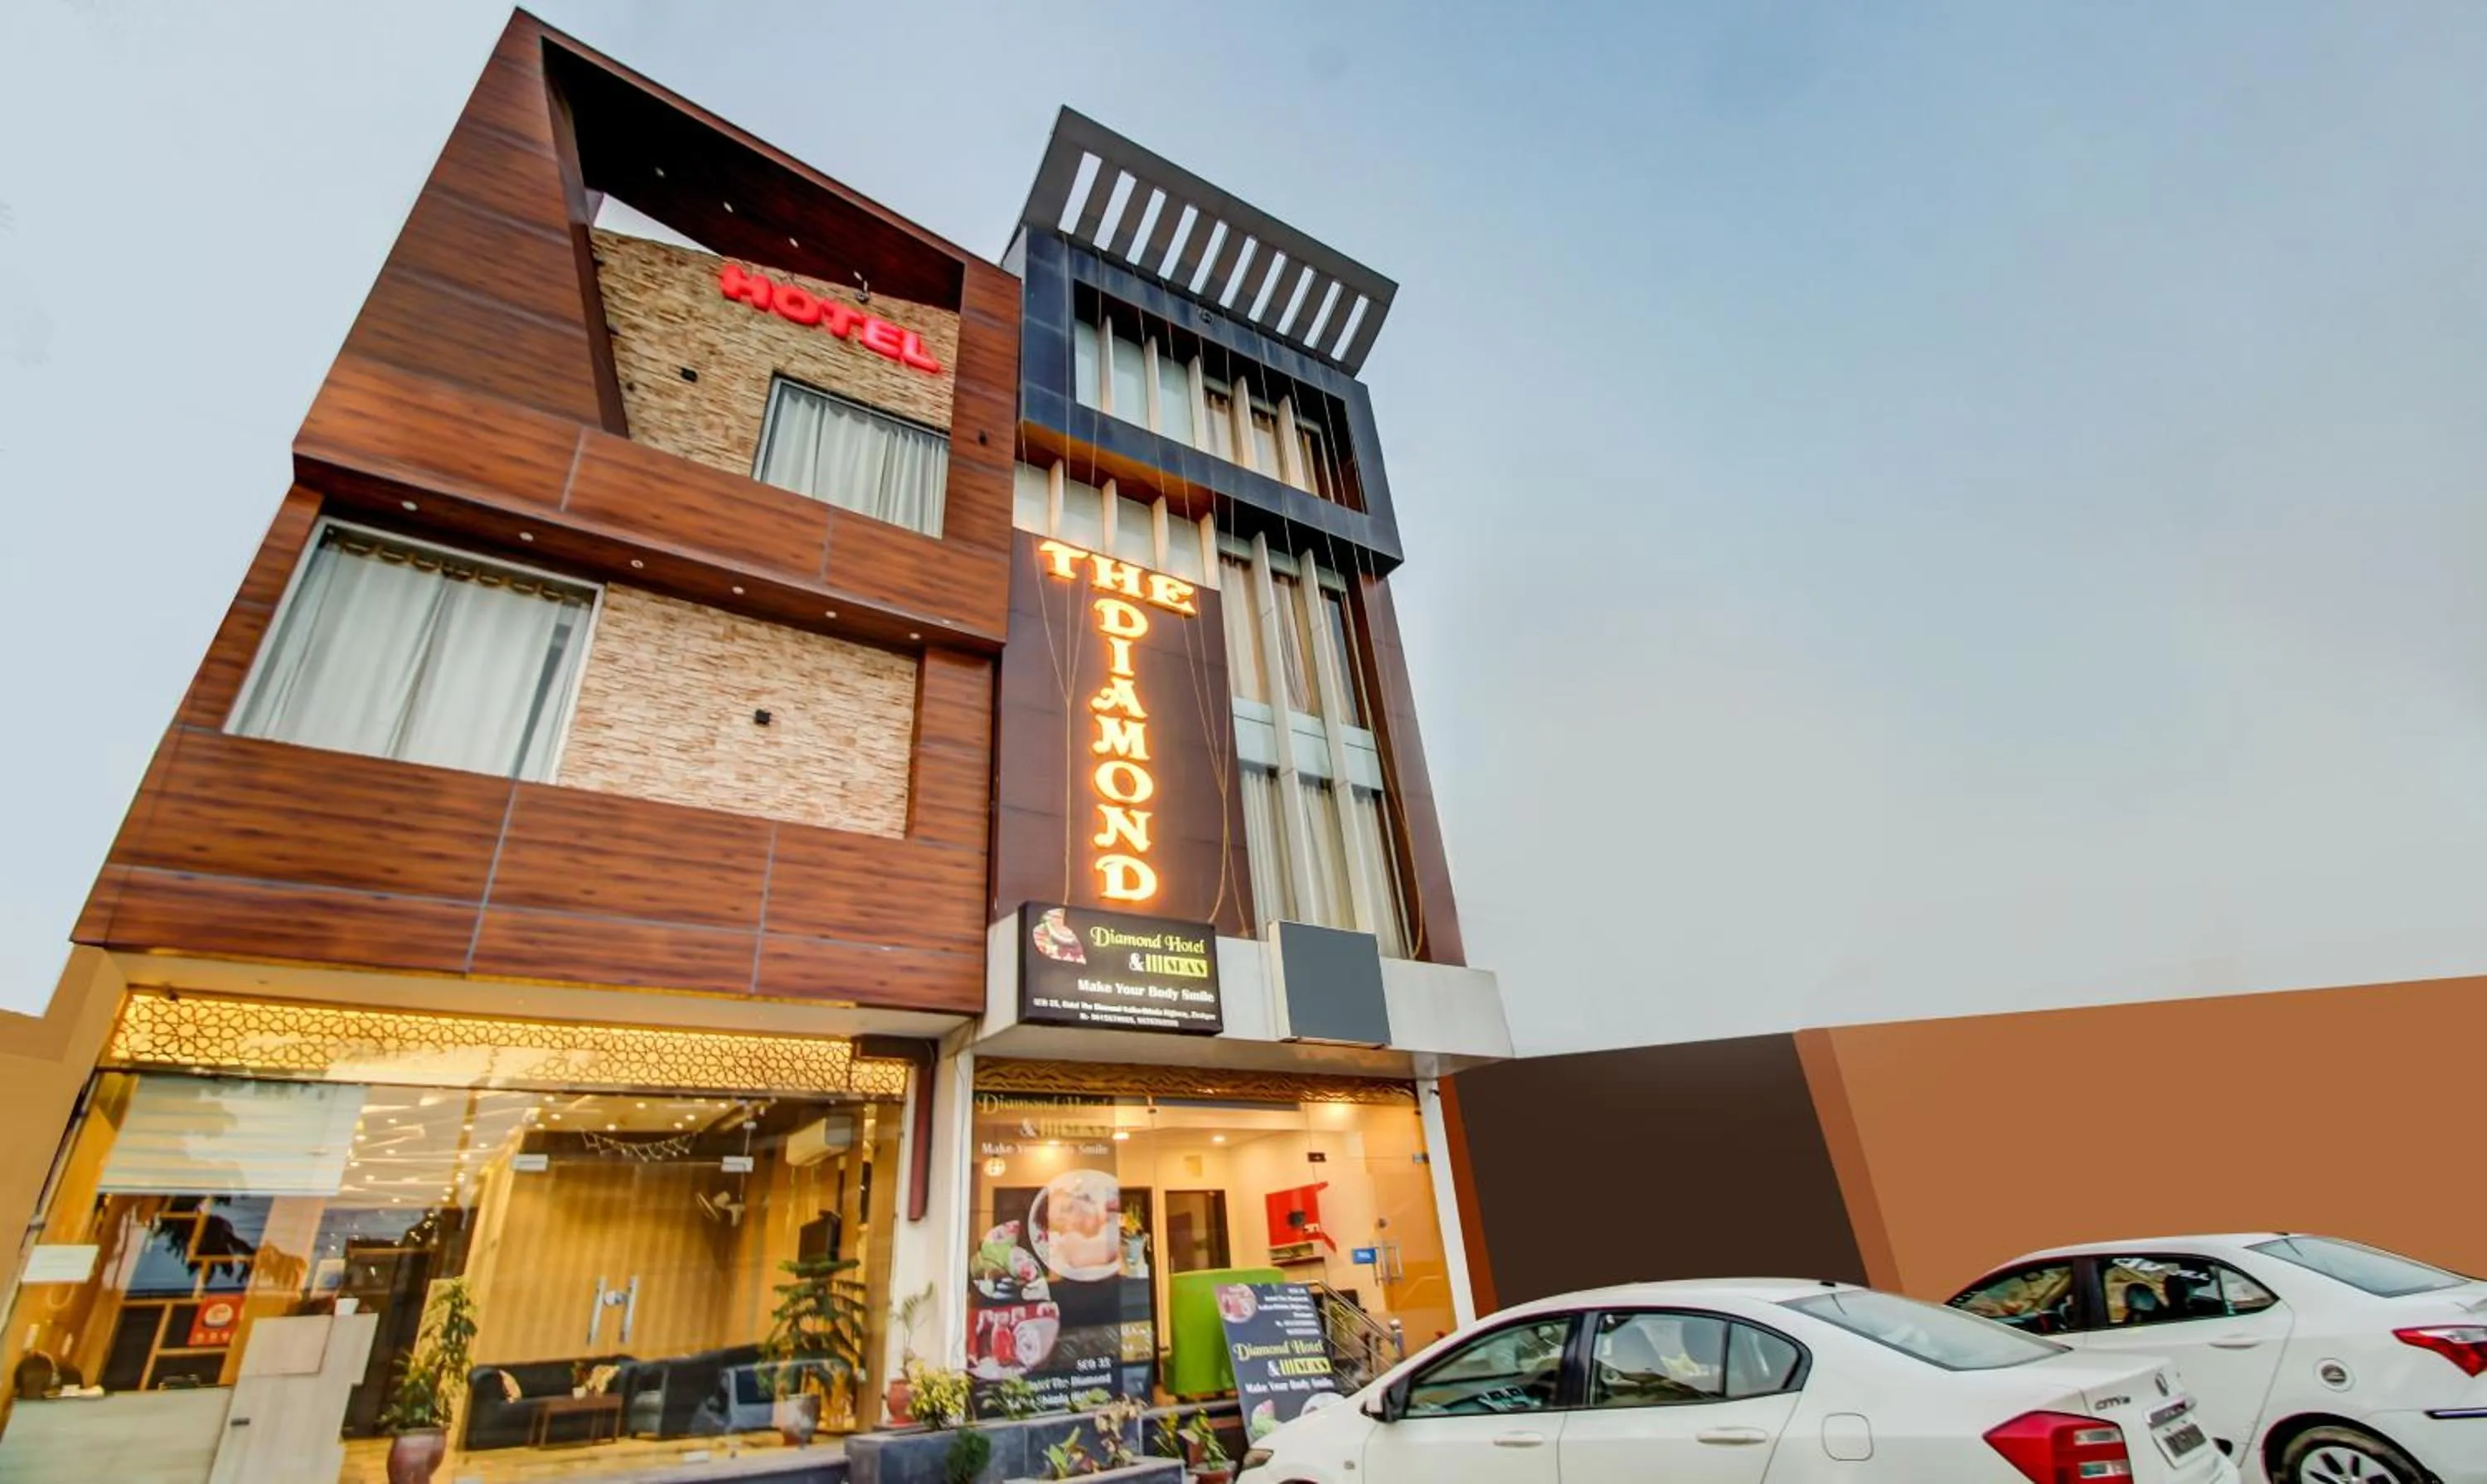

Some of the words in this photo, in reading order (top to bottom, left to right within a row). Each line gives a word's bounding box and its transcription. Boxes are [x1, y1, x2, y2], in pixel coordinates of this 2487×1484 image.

[720, 264, 942, 373] HOTEL
[1039, 540, 1197, 617] THE
[1090, 597, 1158, 902] DIAMOND
[1089, 926, 1161, 948] Diamond
[1164, 934, 1205, 954] Hotel
[1078, 978, 1113, 994] Make
[1115, 982, 1145, 997] Your
[1148, 984, 1179, 1001] Body
[1181, 988, 1214, 1003] Smile
[975, 1093, 1058, 1115] Diamond
[981, 1142, 1013, 1156] Make
[1078, 1142, 1110, 1156] Smile
[1232, 1339, 1290, 1361] Diamond
[1290, 1337, 1326, 1355] Hotel
